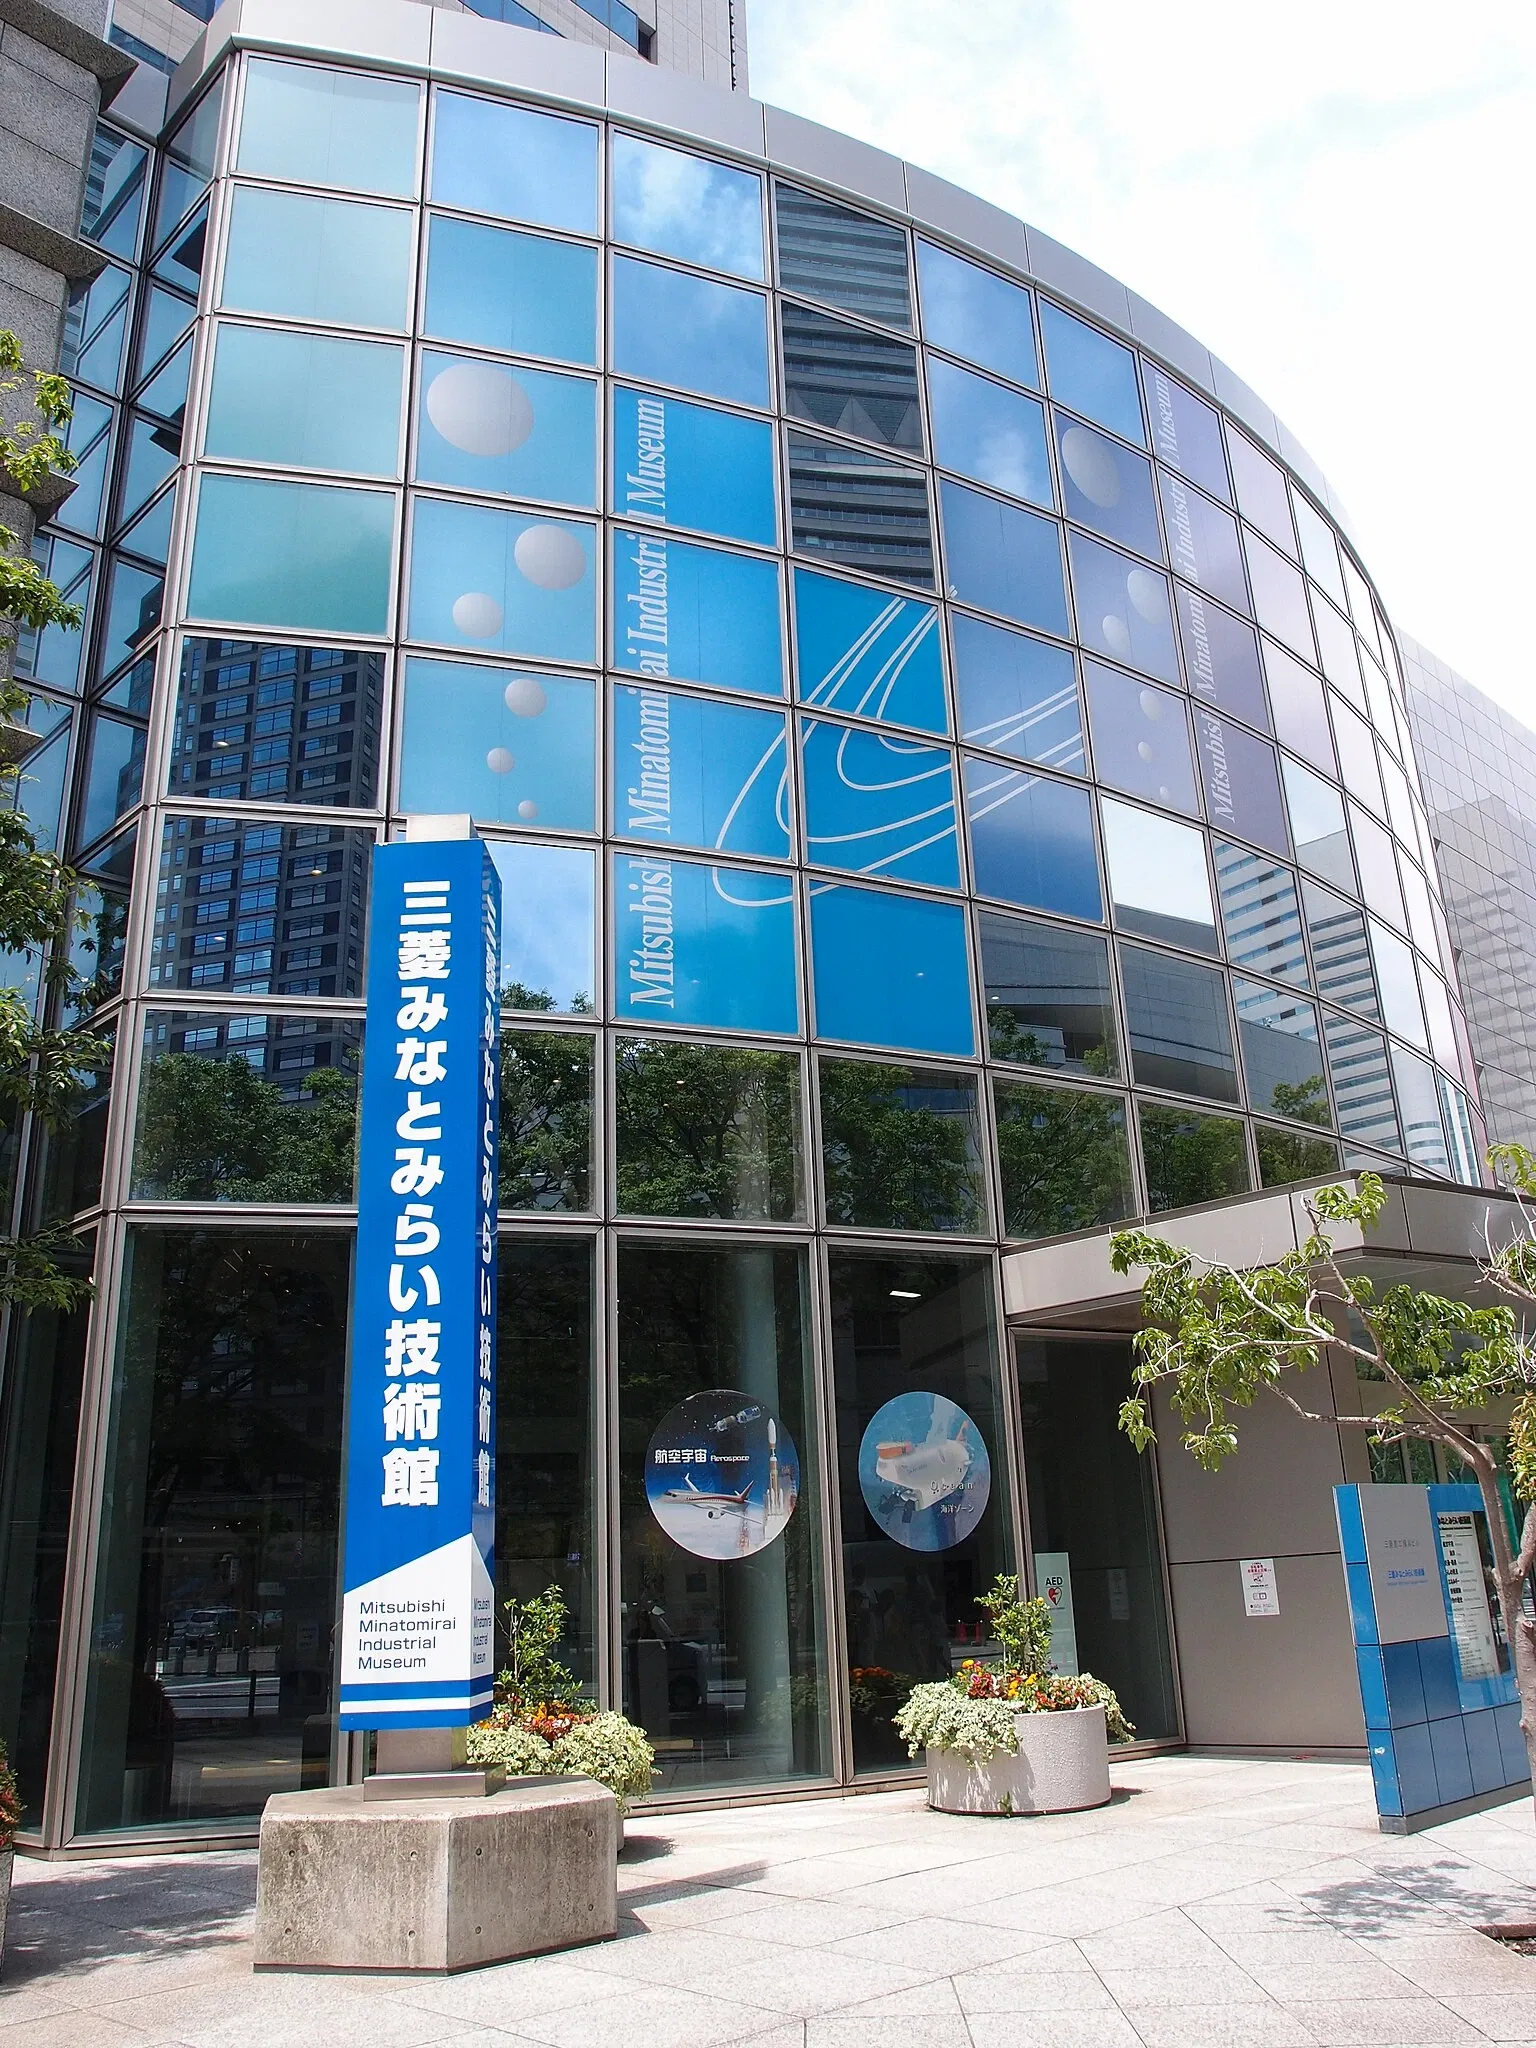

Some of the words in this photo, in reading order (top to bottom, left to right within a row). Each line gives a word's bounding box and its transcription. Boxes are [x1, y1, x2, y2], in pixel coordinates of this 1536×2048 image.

[1154, 372, 1181, 460] Museum
[626, 398, 667, 510] Museum
[1161, 453, 1196, 566] Industril
[626, 509, 669, 647] Industril
[1178, 559, 1217, 700] Minatomiai
[626, 647, 672, 836] Minatomiai
[1200, 711, 1236, 824] Mitsubish
[628, 857, 675, 1009] Mitsubish
[382, 880, 452, 1507] 三菱みなとみらい技術館
[655, 1448, 708, 1464] 航空宇宙
[710, 1455, 750, 1463] Aerospace
[930, 1480, 973, 1492] Ocean
[940, 1504, 975, 1514] 海洋ゾーン
[359, 1599, 446, 1615] Mitsubishi
[1045, 1576, 1063, 1587] AED
[358, 1636, 437, 1651] Industrial
[359, 1617, 456, 1633] Minatomirai
[357, 1656, 426, 1670] Museum
